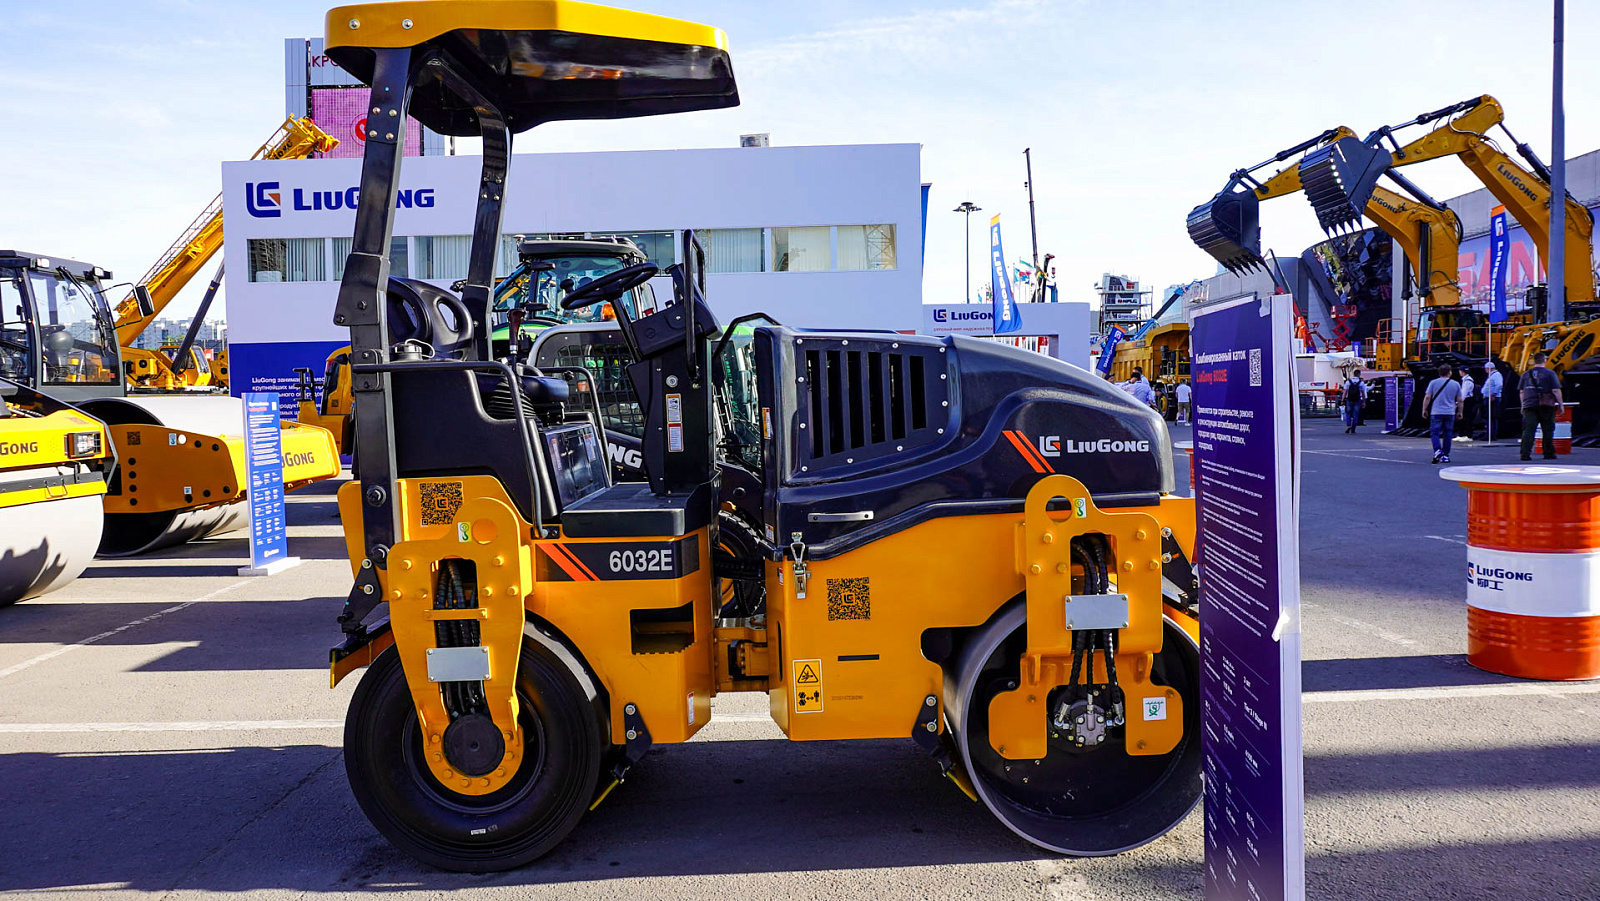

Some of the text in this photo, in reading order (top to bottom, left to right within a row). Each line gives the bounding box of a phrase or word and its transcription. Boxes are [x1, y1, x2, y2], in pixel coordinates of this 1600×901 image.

[293, 187, 435, 211] LIUGNG
[951, 311, 994, 321] LIUGON
[0, 441, 39, 456] GONG
[1067, 439, 1149, 453] LIUGONG
[608, 442, 643, 469] NG
[609, 550, 673, 573] 6032E
[1476, 565, 1533, 582] LIUGONG
